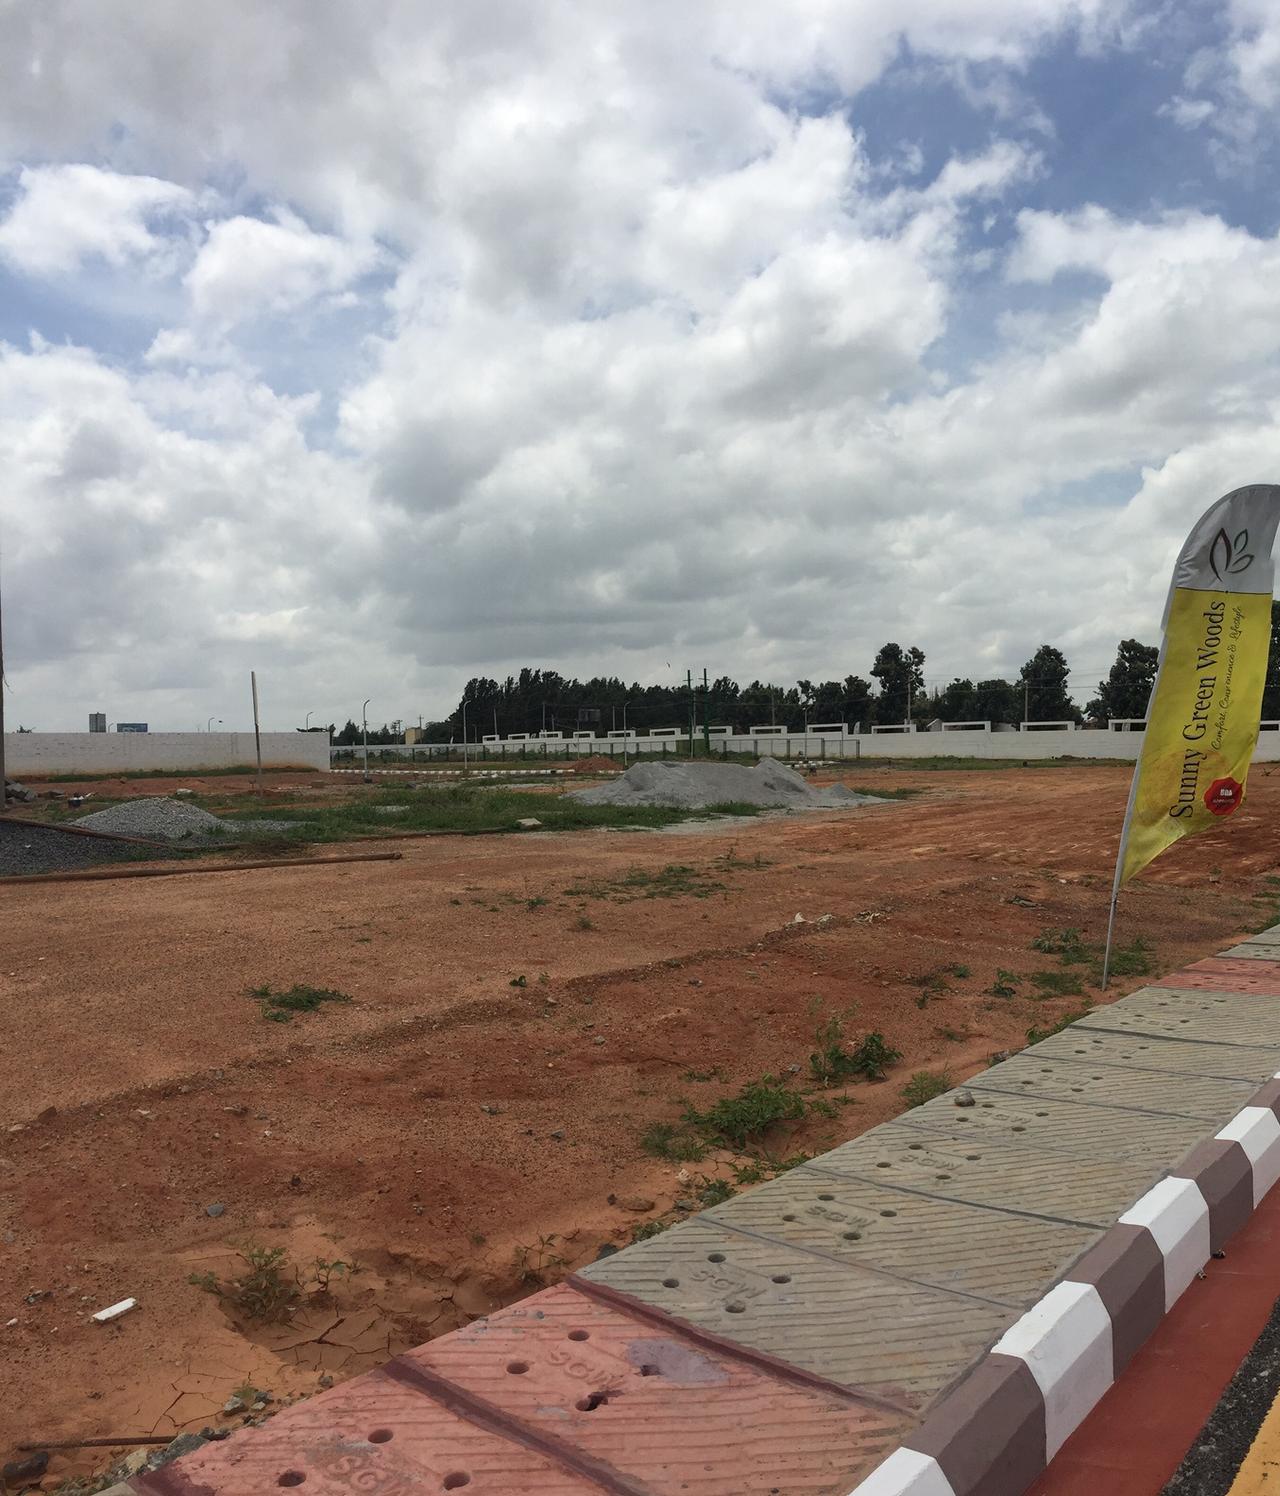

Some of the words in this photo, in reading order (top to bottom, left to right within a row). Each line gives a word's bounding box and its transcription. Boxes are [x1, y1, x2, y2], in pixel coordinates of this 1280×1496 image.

[1195, 601, 1225, 671] Woods
[1182, 676, 1216, 741] Green
[1169, 748, 1207, 818] Sunny
[547, 1350, 628, 1390] SGW
